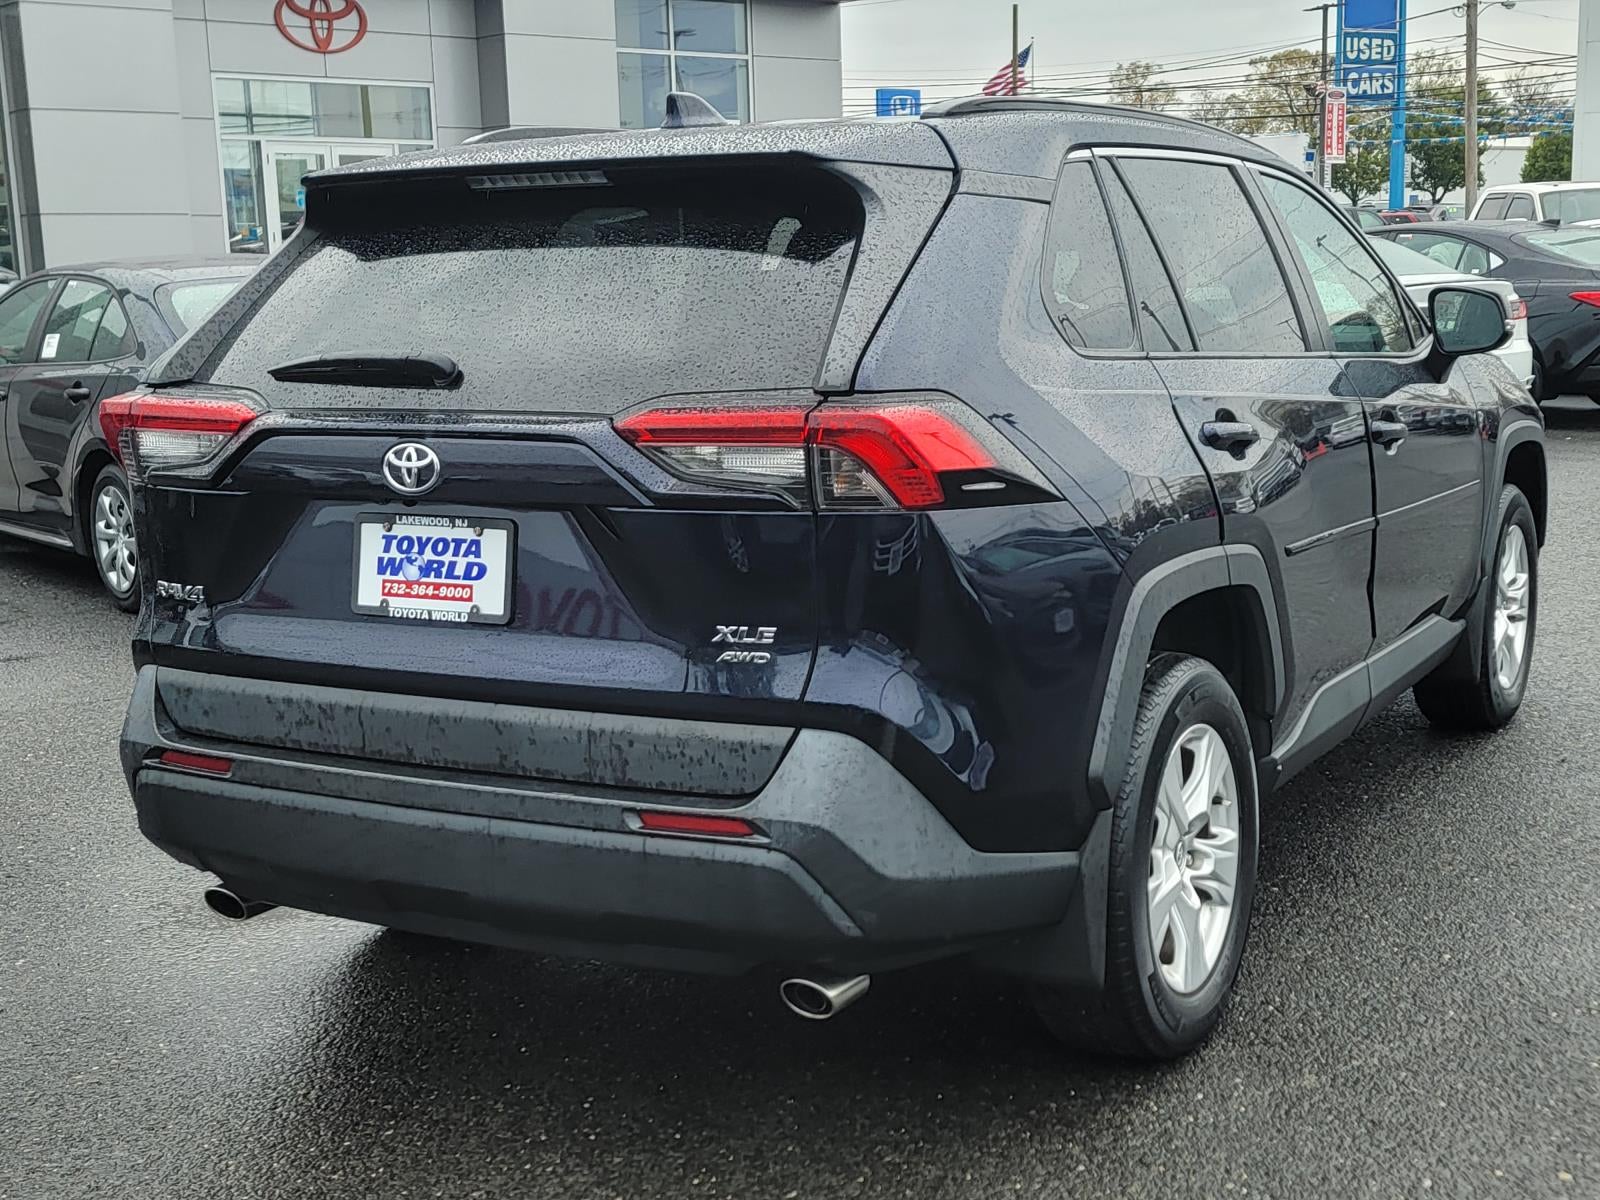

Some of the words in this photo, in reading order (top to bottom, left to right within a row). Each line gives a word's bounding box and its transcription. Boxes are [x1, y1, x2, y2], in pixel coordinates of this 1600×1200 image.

[1346, 37, 1395, 61] USED
[1347, 71, 1394, 95] CARS
[396, 515, 453, 528] LAKEWOOD,
[455, 519, 468, 527] NJ
[381, 534, 482, 559] TOYOTA
[156, 579, 205, 603] RAV4
[384, 583, 471, 598] 732-364-9000
[388, 607, 429, 620] TOYOTA
[431, 610, 469, 622] WORLD
[711, 625, 778, 643] XLE
[716, 651, 771, 663] AWD
